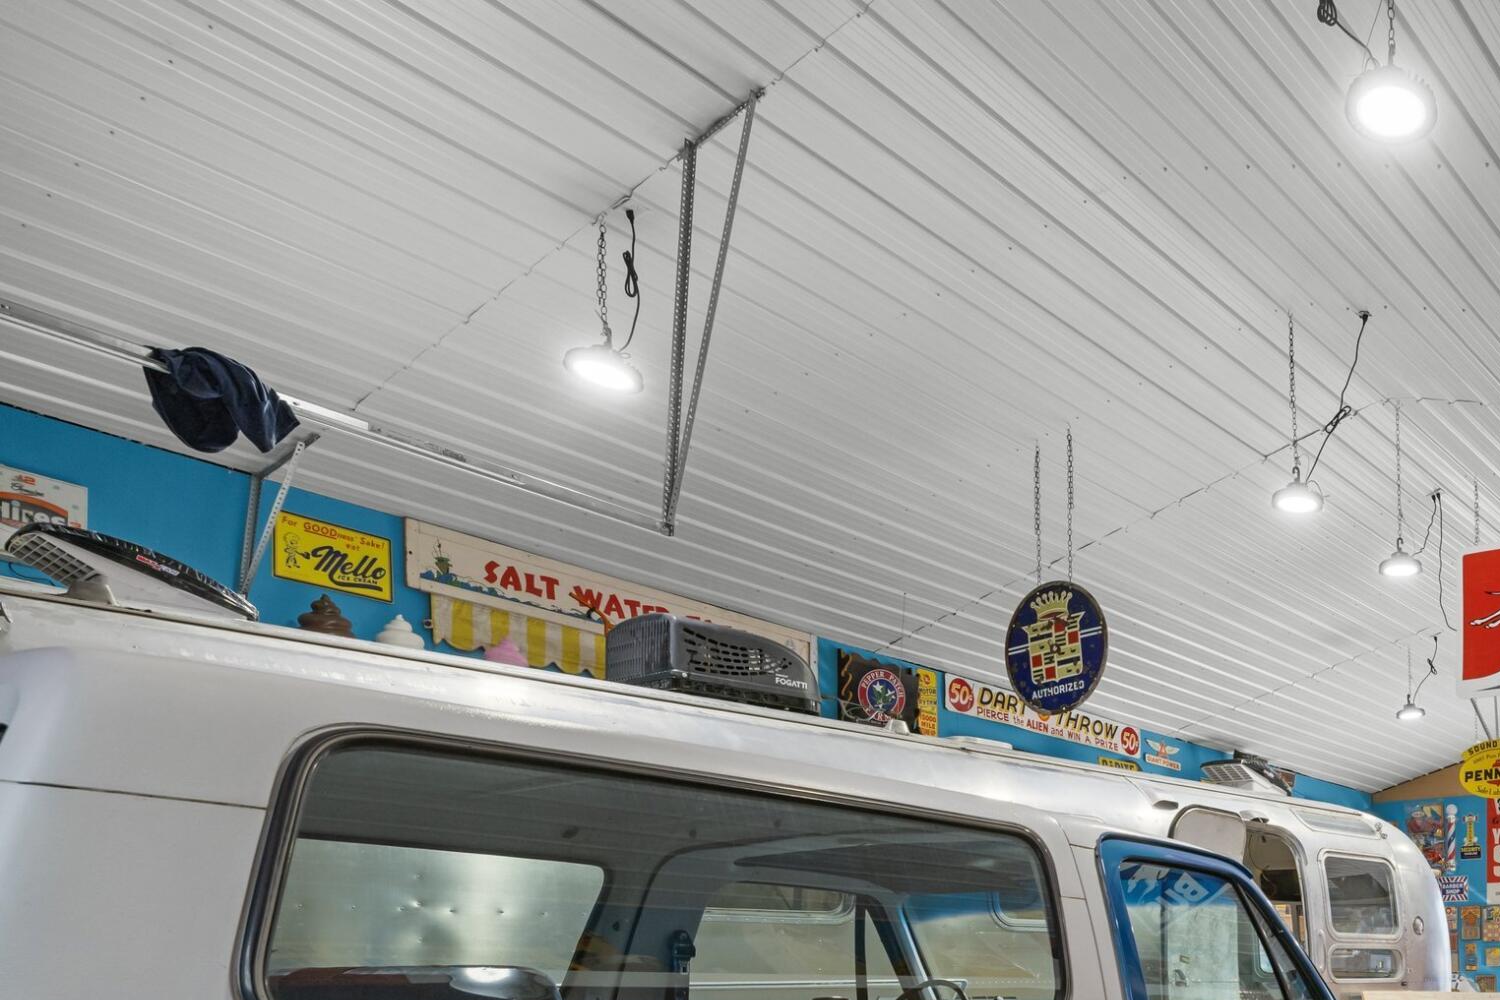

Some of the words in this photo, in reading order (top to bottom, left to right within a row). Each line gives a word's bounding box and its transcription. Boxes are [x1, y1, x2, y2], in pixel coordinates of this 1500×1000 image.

[281, 515, 297, 528] For
[360, 537, 385, 550] Sake!
[311, 545, 387, 585] Mello
[353, 577, 379, 586] CREAM
[484, 560, 560, 600] SALT
[775, 676, 808, 691] FOGATTI
[861, 670, 885, 689] PEPPER
[1032, 680, 1086, 700] AUTHORIZED
[978, 686, 1026, 715] DART
[1055, 708, 1119, 740] THROW
[977, 706, 1010, 722] PIERCE
[1013, 715, 1026, 727] the
[1026, 718, 1050, 734] ALIEN
[1050, 726, 1065, 737] and
[1067, 729, 1082, 742] WIN
[1094, 737, 1120, 752] PRIZE
[1468, 740, 1498, 756] SOUND
